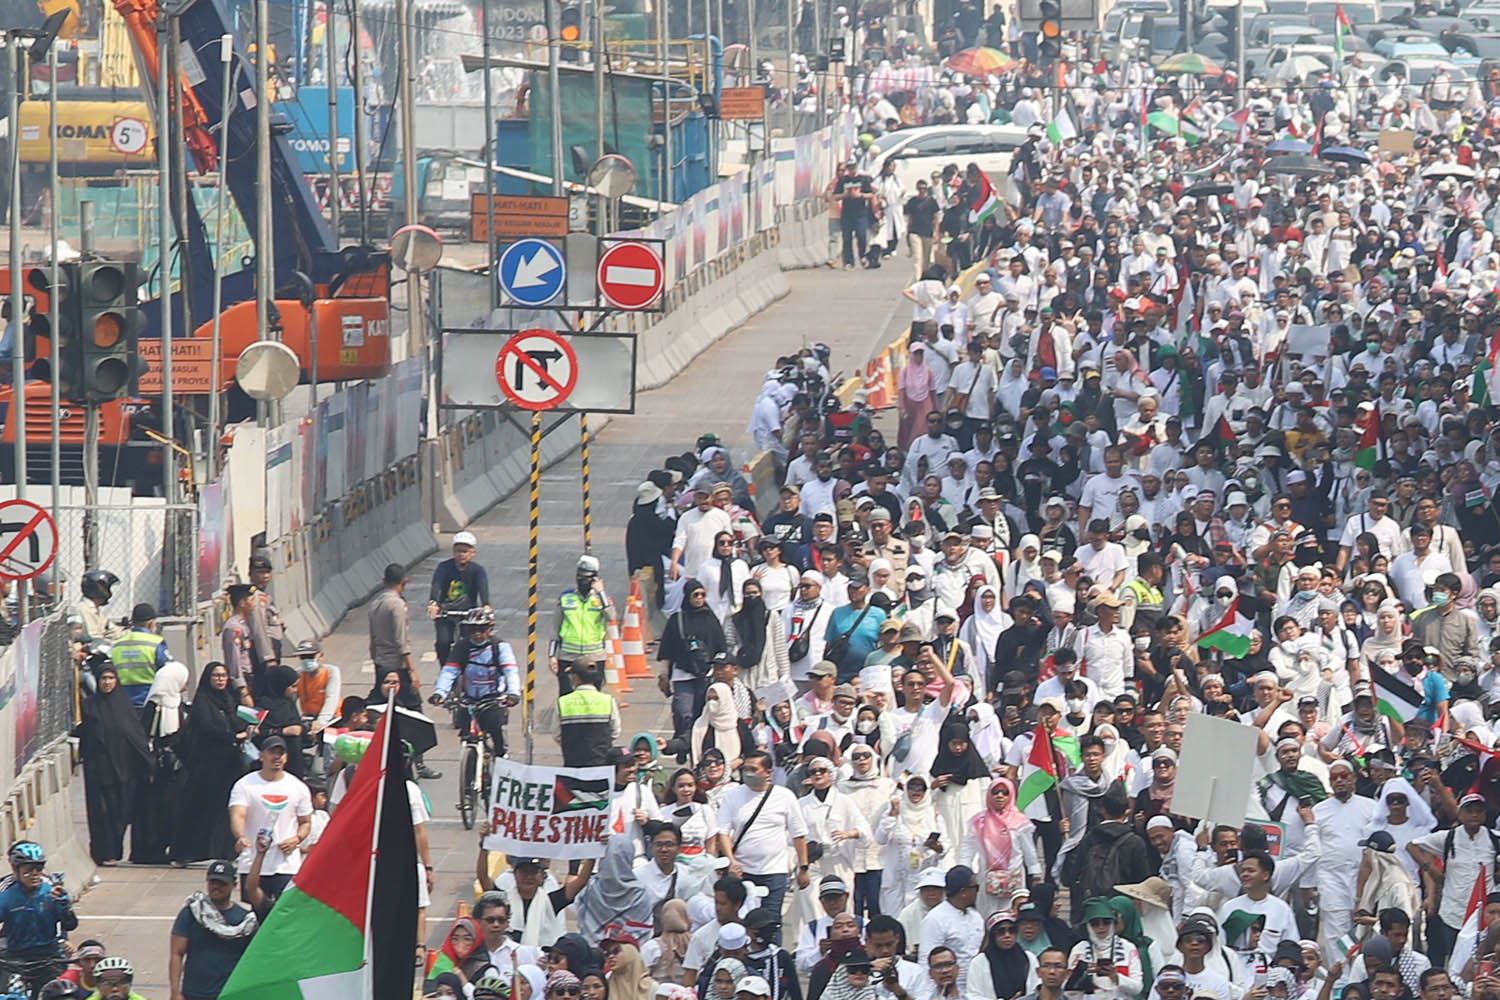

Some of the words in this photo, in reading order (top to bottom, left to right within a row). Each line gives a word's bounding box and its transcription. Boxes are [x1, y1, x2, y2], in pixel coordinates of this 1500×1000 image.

[48, 125, 113, 138] KOMAT
[496, 776, 553, 812] FREE
[492, 806, 608, 845] PALESTINE
